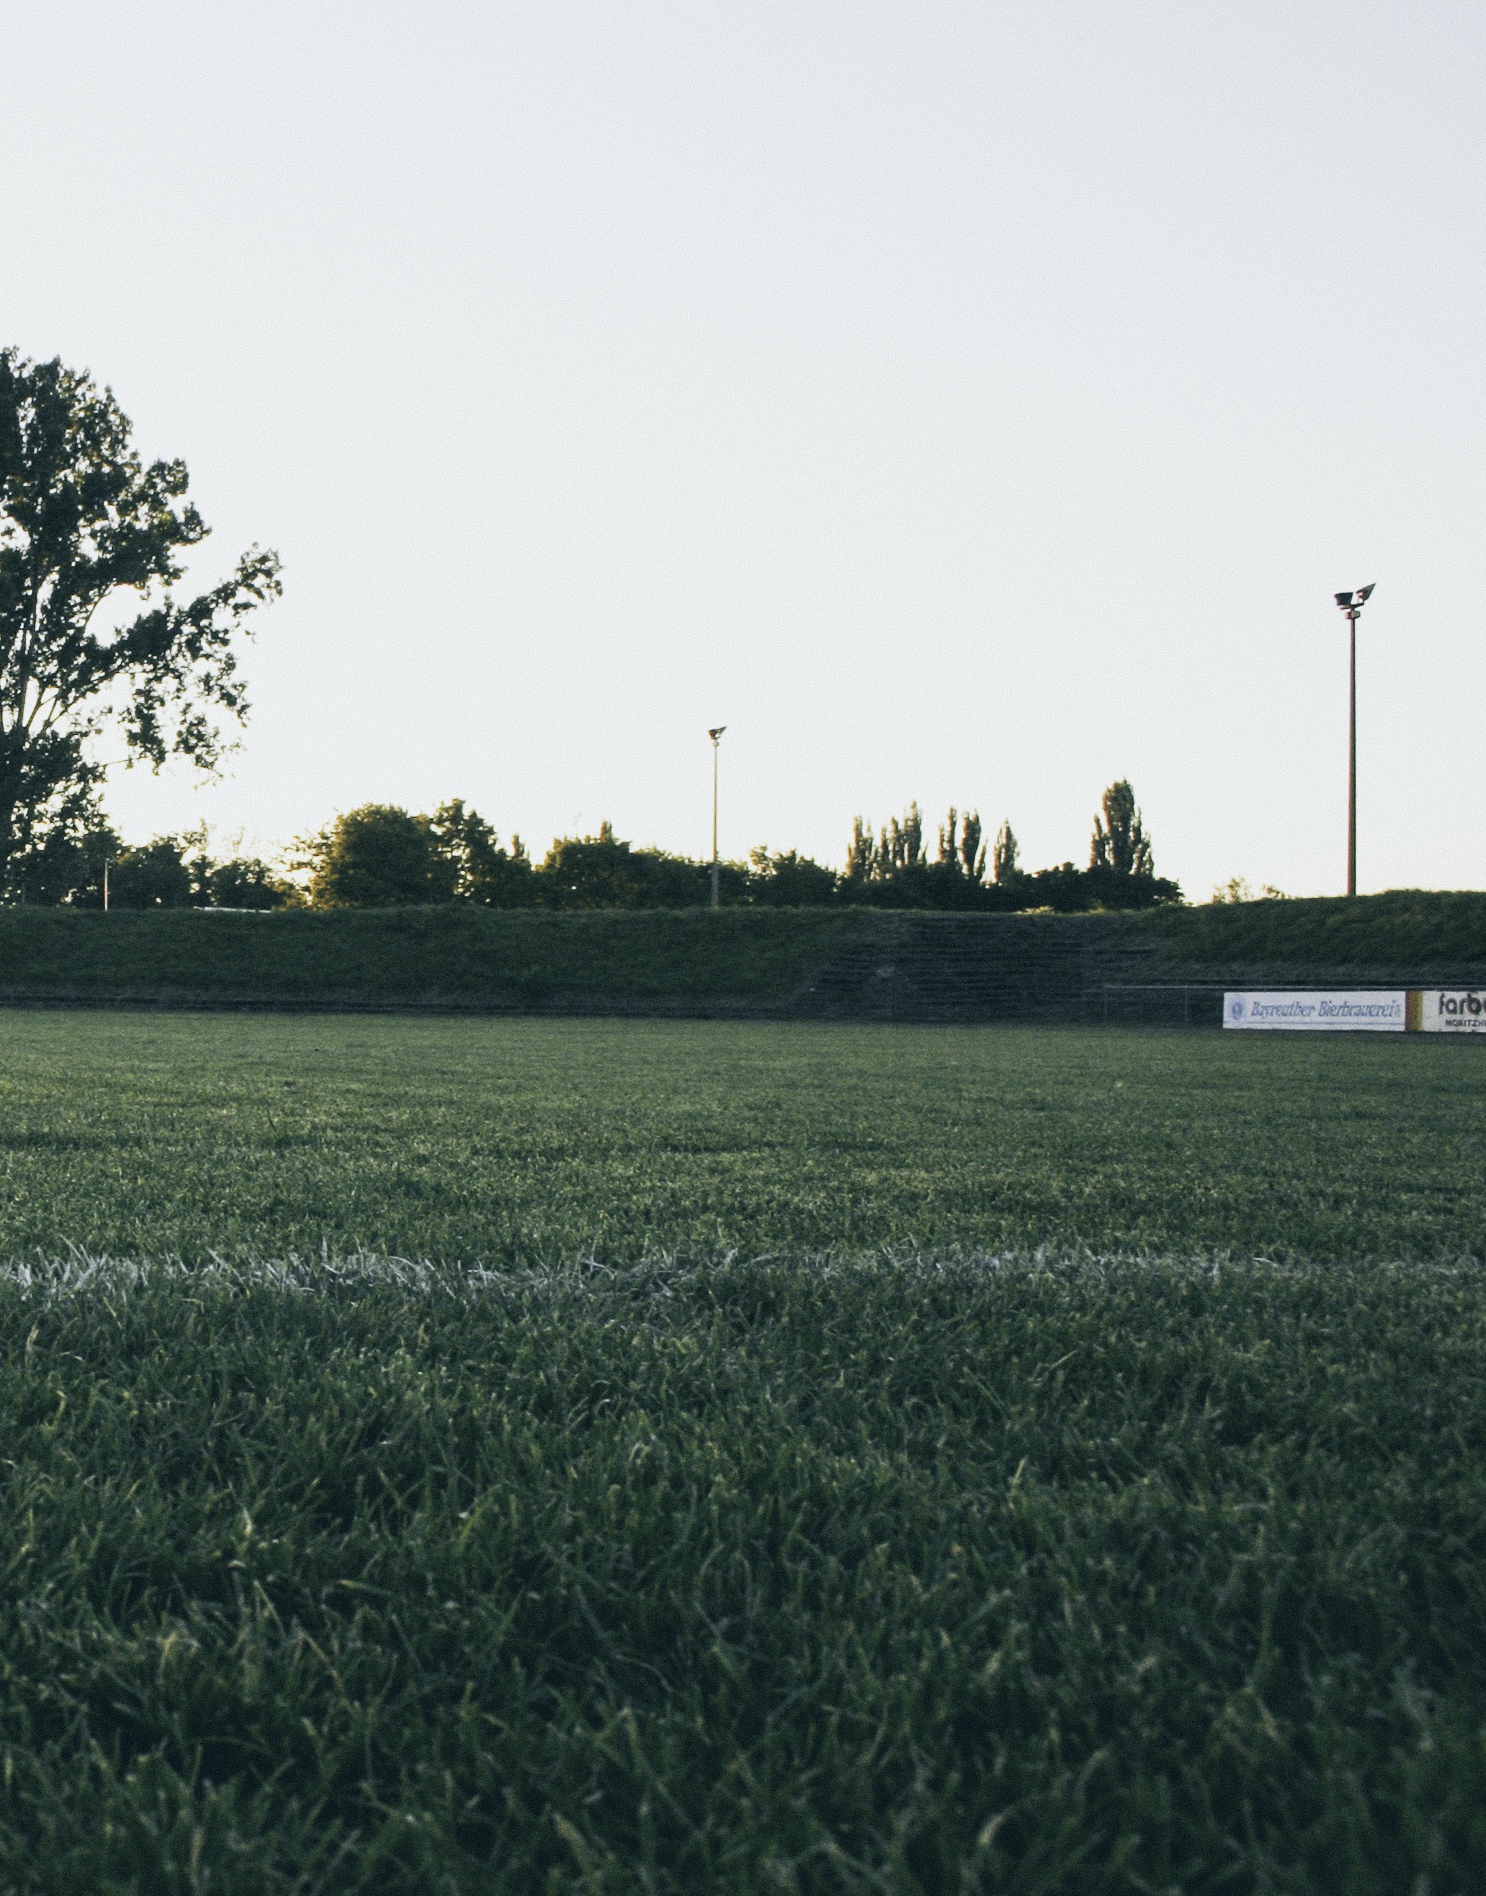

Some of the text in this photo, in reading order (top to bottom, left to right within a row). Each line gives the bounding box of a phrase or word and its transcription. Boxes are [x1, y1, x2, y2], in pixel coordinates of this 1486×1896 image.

[1251, 1001, 1315, 1019] Bayreuther
[1318, 1000, 1396, 1018] Bierbrauerei
[1439, 993, 1486, 1016] farb
